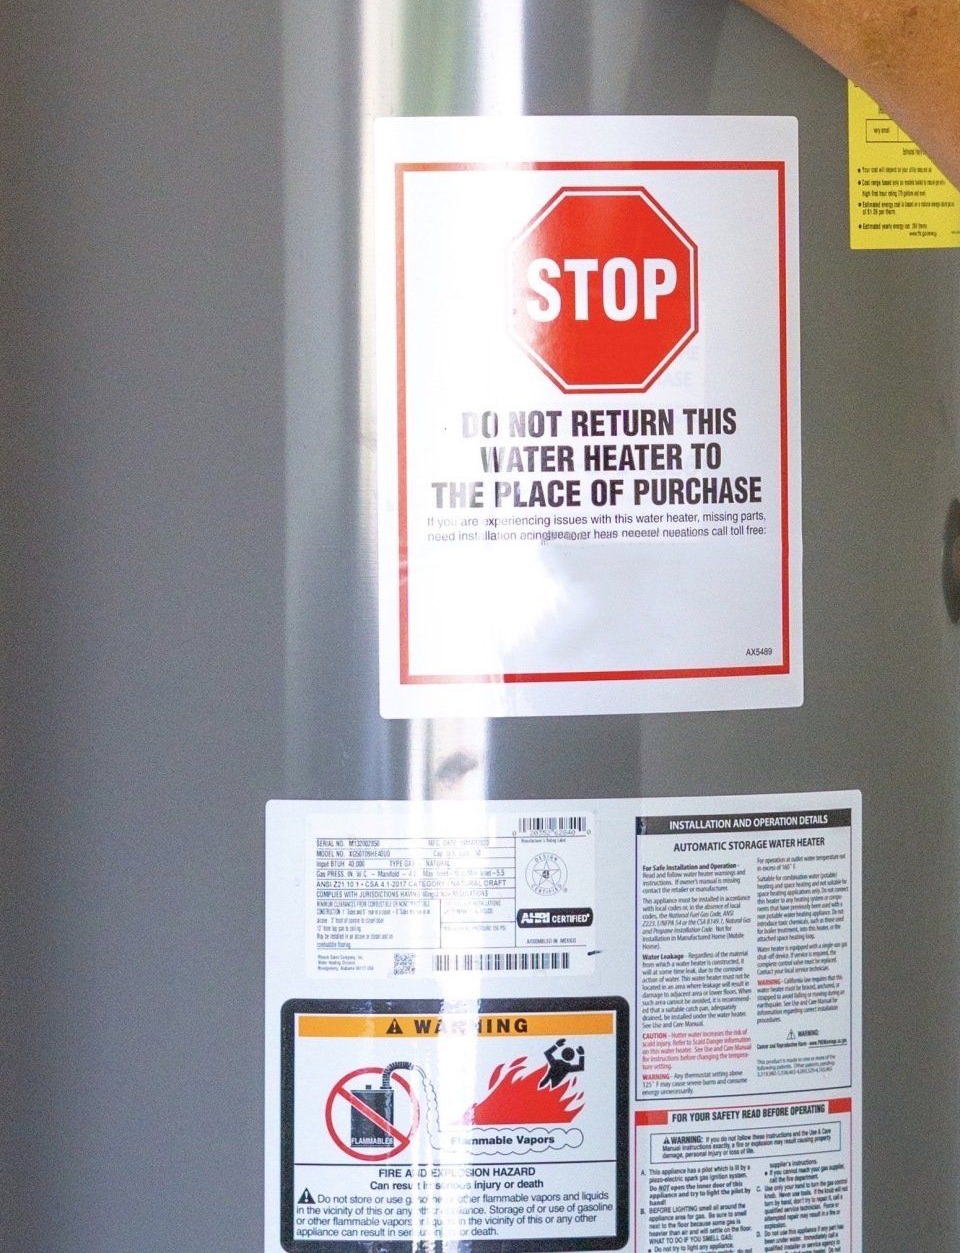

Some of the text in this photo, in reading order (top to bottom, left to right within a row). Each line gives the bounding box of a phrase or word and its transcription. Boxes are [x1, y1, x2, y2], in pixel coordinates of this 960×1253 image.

[526, 257, 677, 322] STOP
[462, 407, 736, 439] DO NOT RETURN THIS
[480, 442, 721, 473] WATER HEATER TO
[432, 476, 762, 508] THE PLACE OF PURCHASE
[460, 518, 478, 526] are
[484, 515, 550, 528] experiencing
[553, 515, 587, 525] issues
[591, 514, 611, 524] with
[615, 513, 633, 523] this
[636, 514, 663, 523] water
[667, 512, 700, 523] heater,
[703, 511, 738, 524] missing
[741, 511, 766, 523] parts,
[428, 531, 455, 541] need
[458, 530, 517, 541] instllation
[712, 526, 728, 536] call
[730, 525, 744, 535] toll
[747, 524, 766, 535] free:
[746, 647, 772, 656] AX5489
[670, 815, 828, 830] INSTALLATION AND OPERATION DETAILS
[674, 837, 825, 852] AUTOMATIC STORAGE WATER HEATER
[711, 862, 737, 870] Operation
[521, 912, 587, 924] AHRI CERTIFIED
[661, 953, 684, 961] Leakage
[414, 1018, 528, 1034] WAING
[672, 1104, 825, 1123] FOR YOUR SAFETY READ BEFORE OPERATING
[516, 1135, 555, 1146] Vapors
[671, 1135, 704, 1144] WARNING:
[379, 1169, 402, 1177] FIRE
[493, 1167, 536, 1177] HAZARD
[370, 1181, 389, 1190] Can
[392, 1181, 420, 1190] resut
[474, 1180, 501, 1190] injury
[504, 1181, 514, 1189] or
[517, 1179, 544, 1188] death
[318, 1194, 331, 1203] Do
[333, 1194, 347, 1203] not
[350, 1194, 372, 1203] store
[375, 1195, 384, 1203] or
[387, 1195, 403, 1203] use
[482, 1193, 529, 1203] flammable
[531, 1194, 560, 1204] vapors
[563, 1192, 580, 1201] and
[582, 1191, 609, 1201] liquids
[296, 1206, 305, 1214] in
[307, 1206, 321, 1214] the
[323, 1205, 353, 1216] vicinity
[355, 1205, 364, 1214] of
[366, 1205, 383, 1214] this
[396, 1207, 412, 1217] any
[489, 1204, 524, 1215] Storage
[526, 1204, 536, 1213] of
[537, 1205, 546, 1213] or
[548, 1205, 564, 1213] use
[567, 1203, 576, 1212] of
[577, 1202, 613, 1213] gasoline
[307, 1217, 331, 1225] other
[333, 1216, 380, 1225] flammable
[382, 1218, 413, 1227] vapors
[468, 1216, 483, 1225] the
[485, 1215, 515, 1226] vicinity
[516, 1215, 526, 1224] of
[527, 1214, 543, 1224] this
[556, 1215, 573, 1225] any
[575, 1214, 597, 1223] other
[296, 1228, 339, 1237] appliance
[341, 1228, 358, 1236] can
[360, 1227, 385, 1236] result
[387, 1227, 396, 1236] in
[471, 1226, 499, 1236] death.
